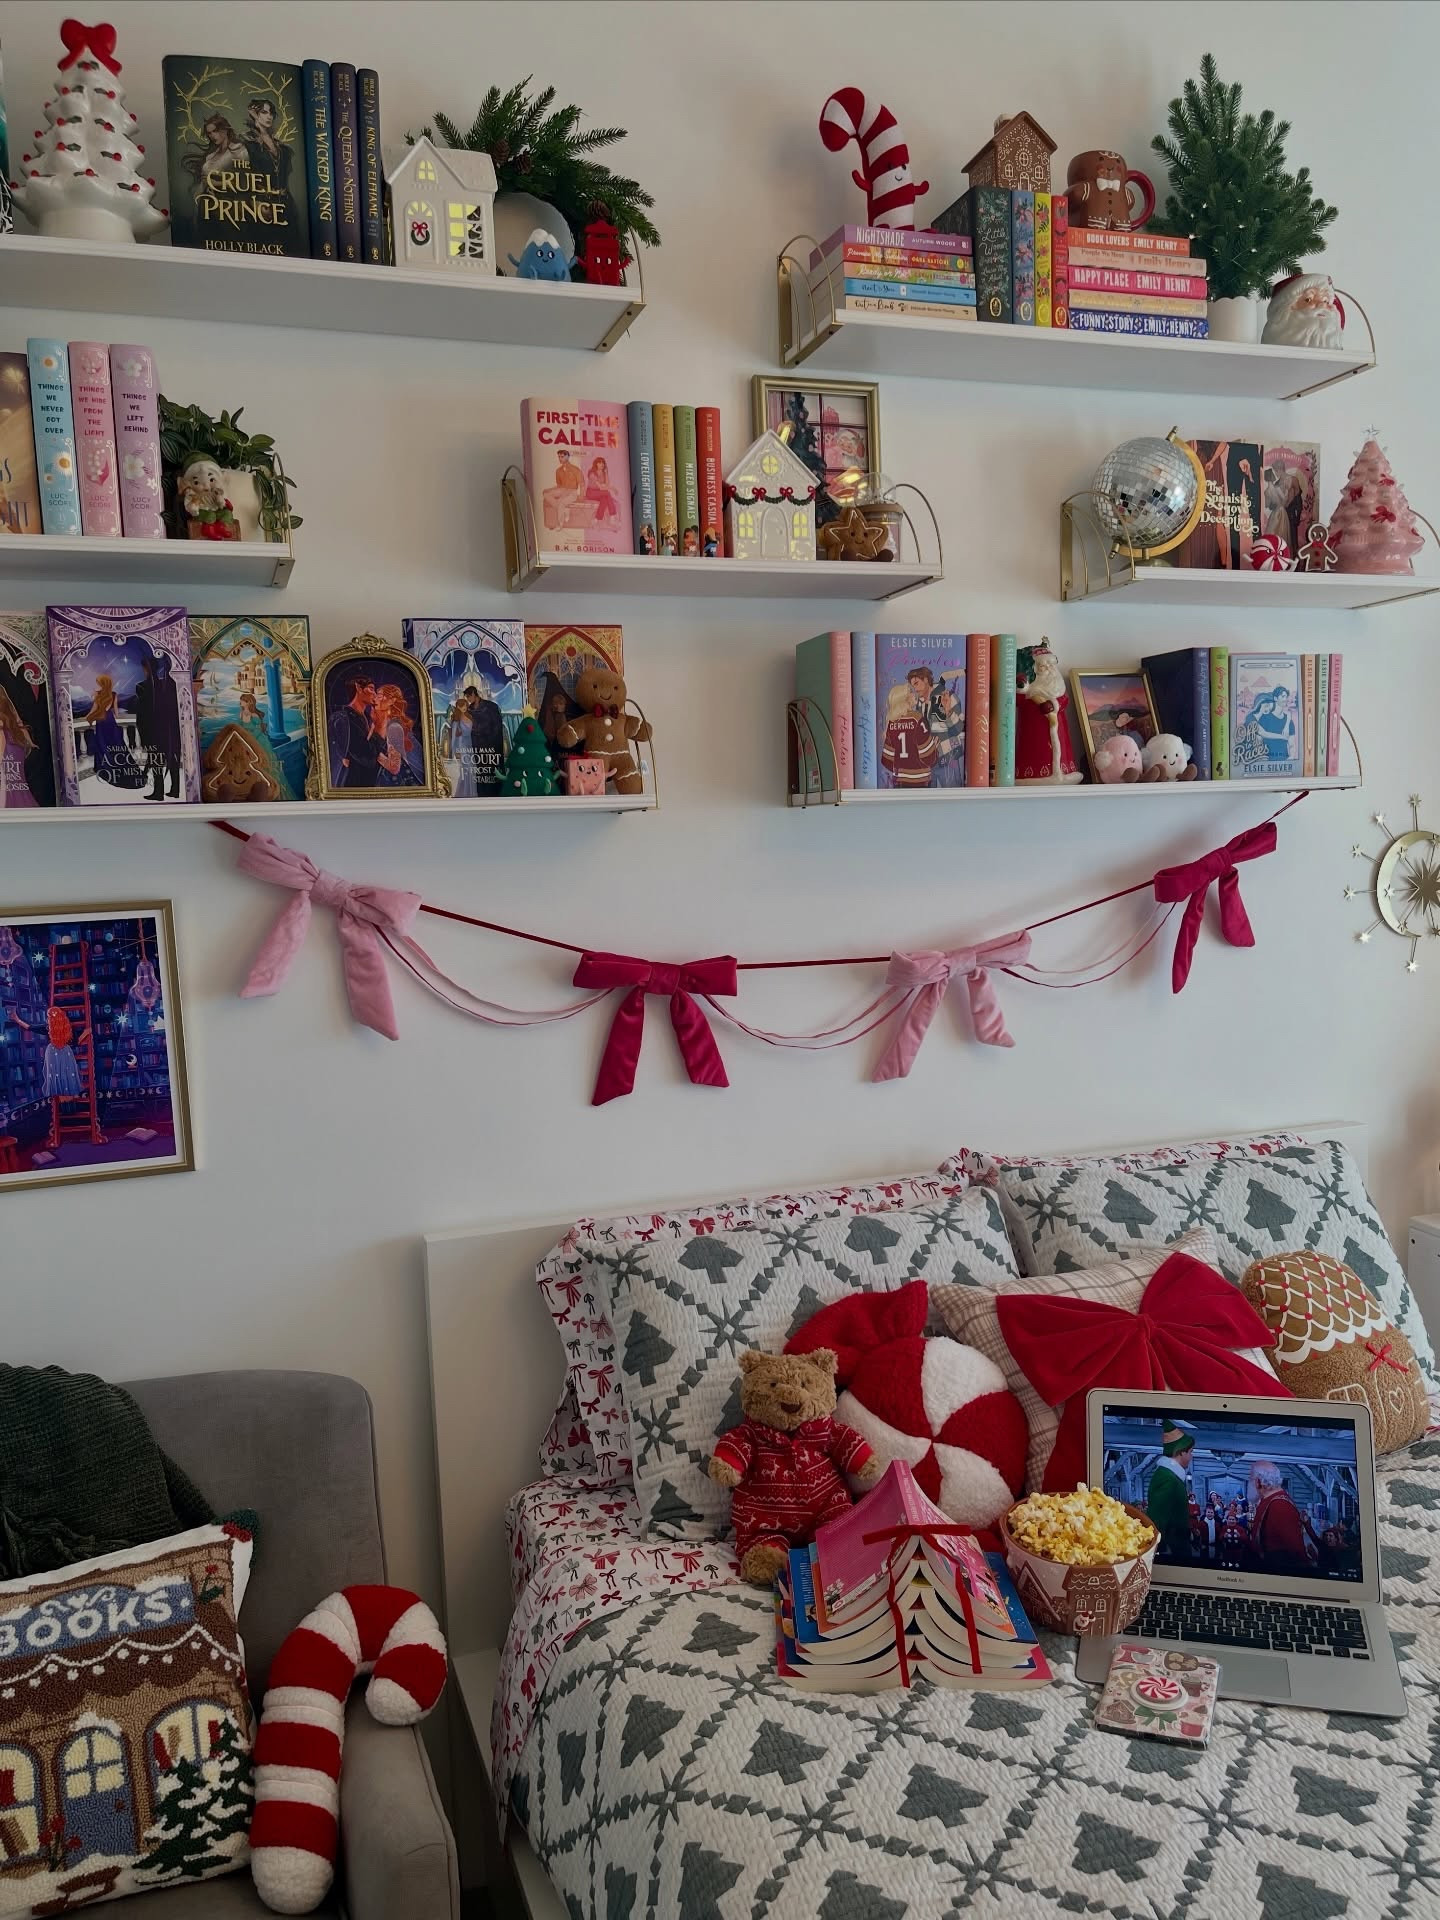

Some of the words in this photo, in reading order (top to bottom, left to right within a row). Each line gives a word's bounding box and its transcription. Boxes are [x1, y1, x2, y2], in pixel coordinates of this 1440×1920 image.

[315, 107, 327, 129] THE
[338, 126, 354, 166] QUEEN
[366, 126, 376, 150] KING
[232, 159, 250, 169] THE
[315, 132, 329, 182] WICKED
[367, 153, 376, 168] OF
[206, 170, 280, 195] CRUEL
[315, 186, 332, 222] KING
[343, 178, 356, 224] NOTHING
[367, 171, 378, 218] ELFHAME
[195, 195, 288, 230] PRINCE
[856, 227, 905, 247] NIGHTSHADE
[911, 237, 934, 245] AUTUMN
[981, 228, 1006, 242] Little
[1086, 233, 1104, 244] BOOK
[1106, 235, 1130, 246] LOVERS
[1133, 237, 1155, 248] EMILY
[1156, 239, 1178, 251] HENRY
[205, 240, 244, 252] HOLLY
[247, 242, 284, 255] BLACK
[1074, 269, 1101, 285] HAPPY
[1104, 272, 1130, 288] PLACE
[1136, 274, 1161, 290] EMILY
[1165, 277, 1191, 293] HENRY
[1080, 313, 1106, 329] FUNNY
[1109, 315, 1134, 331] STORY
[1143, 318, 1166, 333] EMILY
[1169, 320, 1194, 335] HENRY
[40, 405, 64, 413] NEVER
[536, 411, 620, 428] FIRST-TIME
[537, 427, 619, 448] CALLER
[640, 452, 651, 491] LOVELIGHT
[663, 464, 672, 472] IN
[685, 462, 694, 485] MIXED
[706, 458, 716, 494] BUSINESS
[663, 475, 672, 489] THE
[642, 494, 652, 519] FARMS
[664, 491, 673, 516] WEEDS
[686, 487, 696, 519] SIGNALS
[707, 496, 718, 525] CASUAL
[1204, 493, 1252, 511] Spanish
[1199, 511, 1259, 535] Deception
[577, 545, 615, 553] BORISON
[891, 638, 918, 648] ELSIE
[921, 638, 953, 648] SILVER
[977, 638, 986, 663] ELSIE
[1006, 637, 1014, 664] ELSIE
[977, 664, 986, 694] SILVER
[1006, 665, 1014, 693] SILVER
[889, 721, 915, 730] GERVAIS
[1235, 720, 1258, 742] Off
[898, 732, 909, 758] 1
[1232, 744, 1269, 766] Races
[114, 752, 167, 767] CORT
[461, 753, 501, 766] COURT
[1244, 764, 1264, 772] ELSIE
[1267, 763, 1293, 772] SILVER
[5, 783, 30, 791] OSES
[96, 768, 122, 784] OF
[0, 1590, 173, 1656] BOOKS
